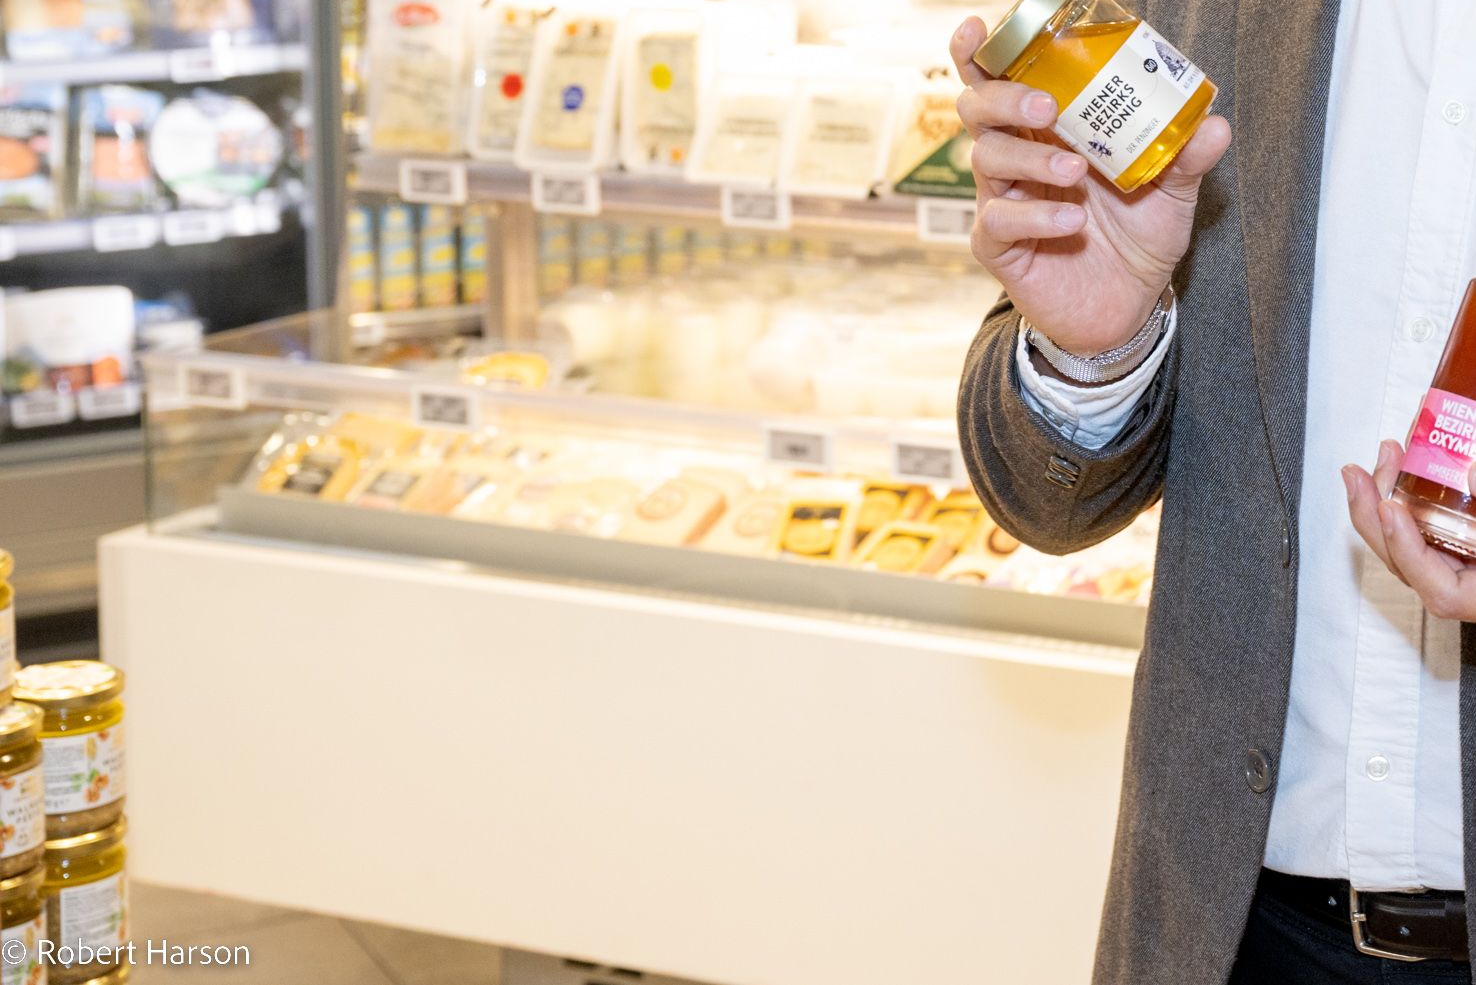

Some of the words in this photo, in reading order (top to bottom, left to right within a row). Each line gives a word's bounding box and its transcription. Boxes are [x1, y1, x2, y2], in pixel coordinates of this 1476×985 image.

[1079, 75, 1123, 121] WIENER
[1090, 84, 1134, 132] BEZIRKS
[1103, 97, 1142, 138] HONIG
[1126, 142, 1139, 154] DER
